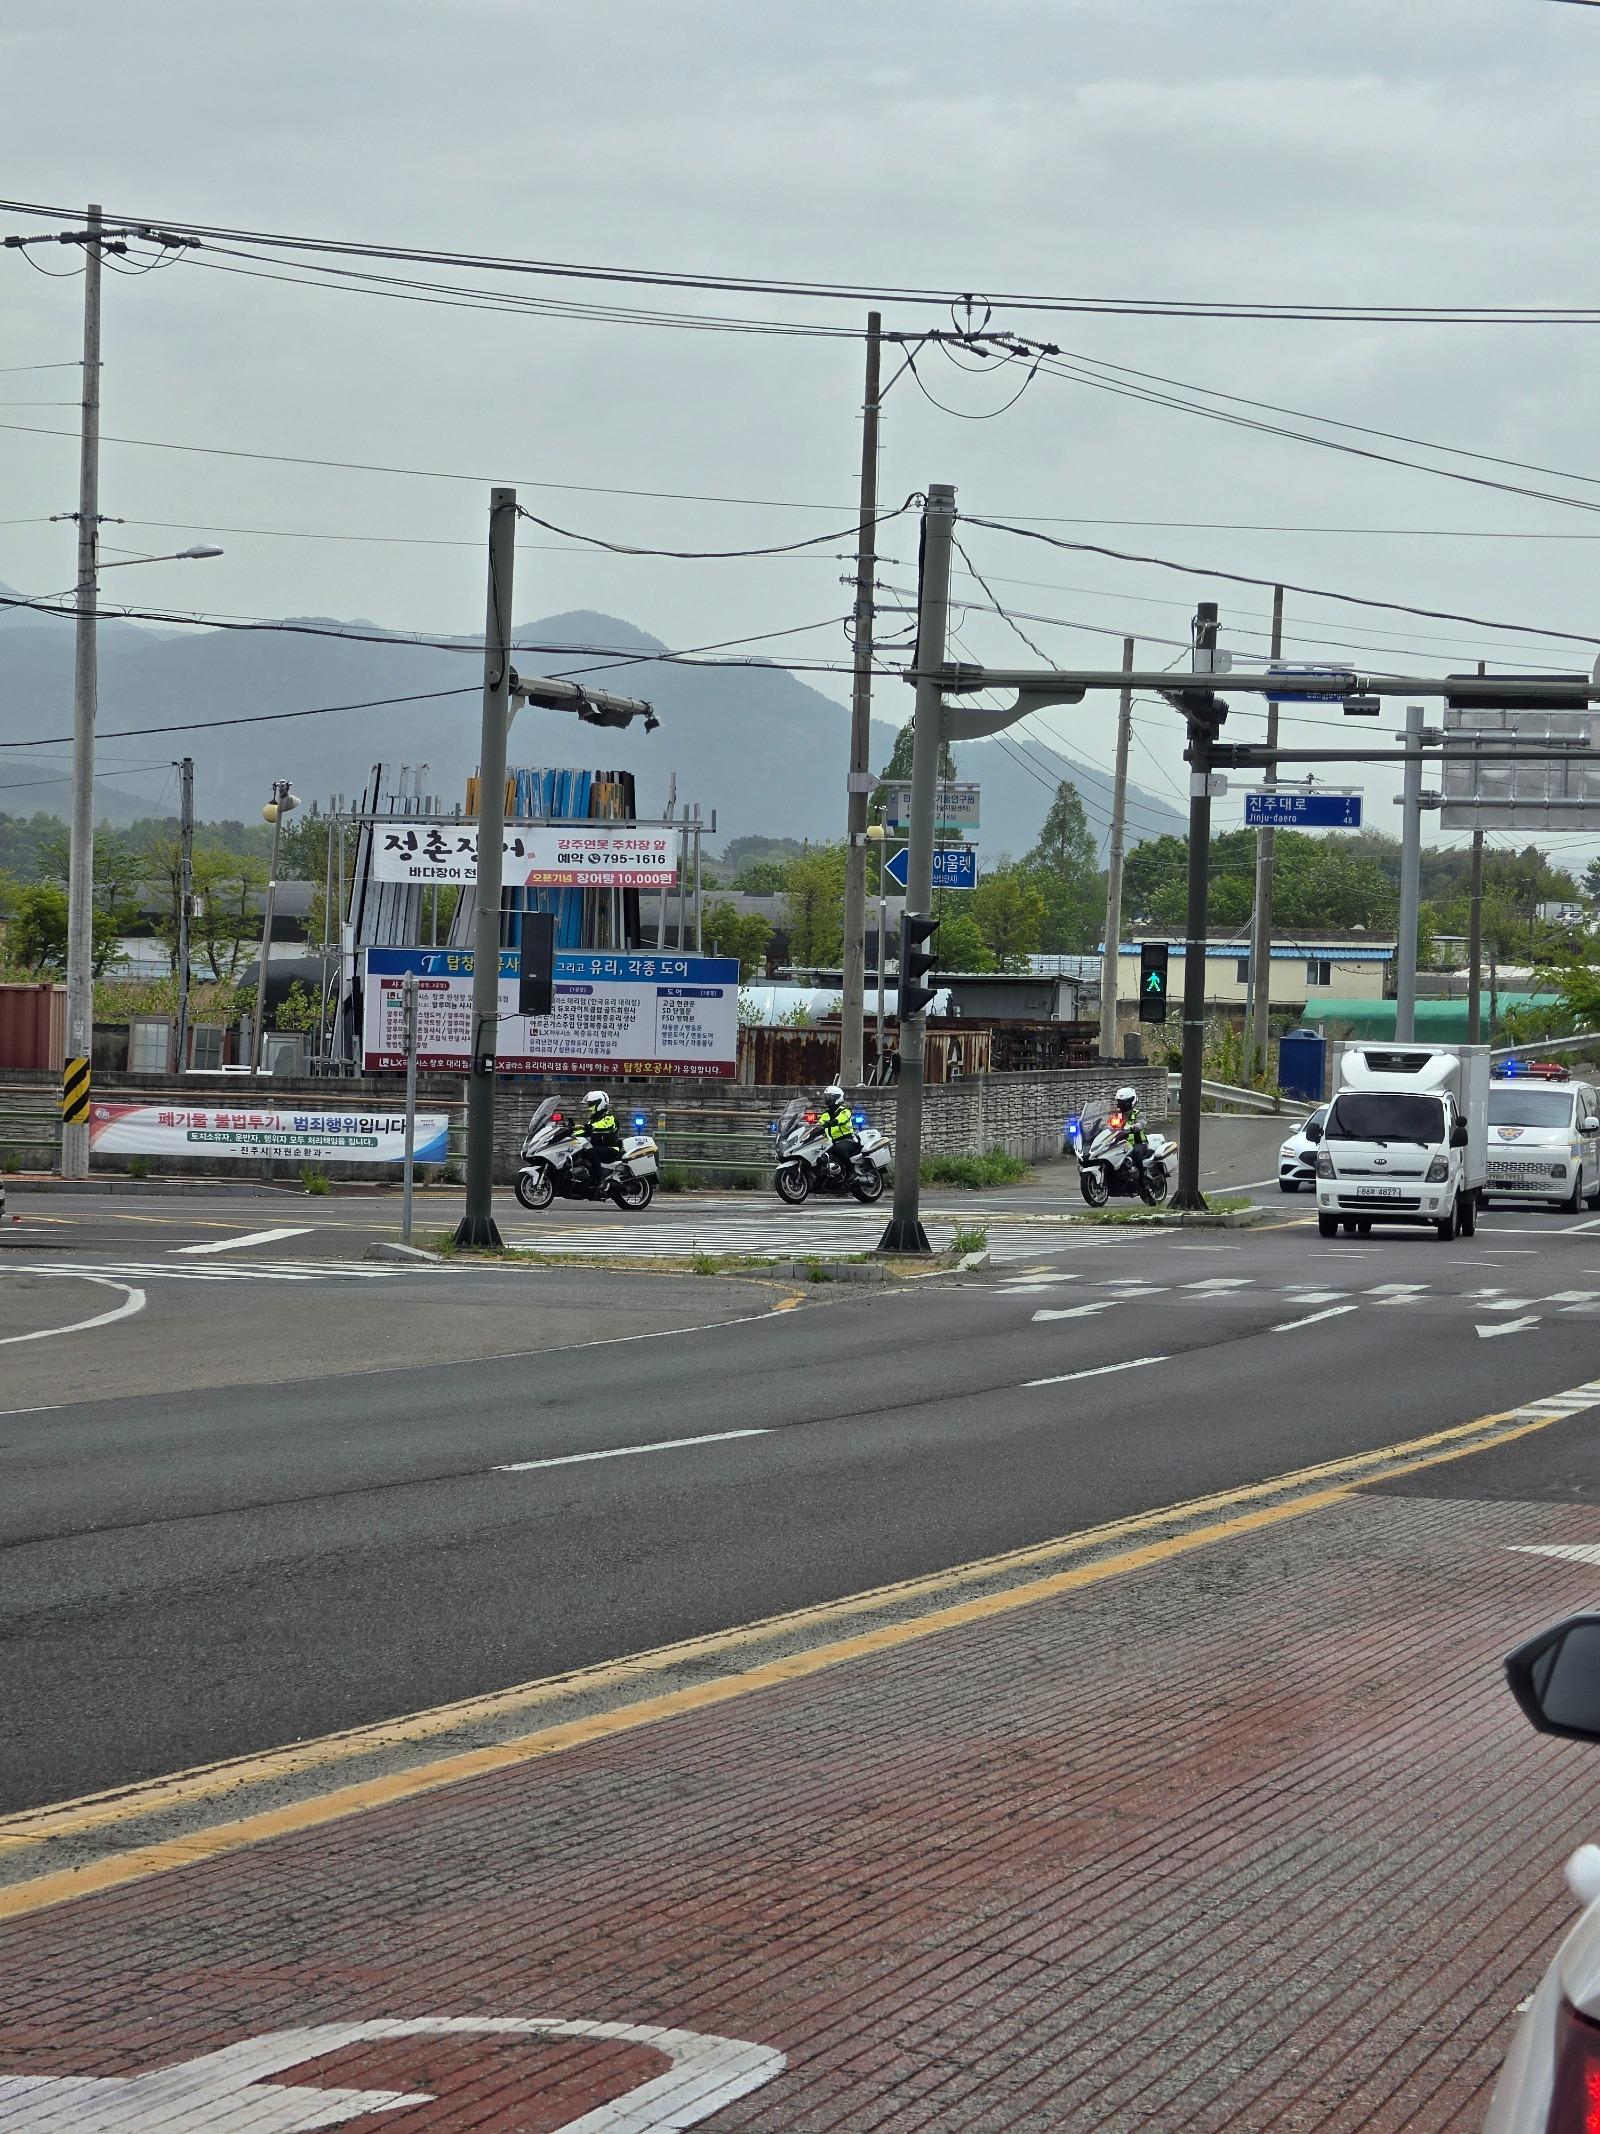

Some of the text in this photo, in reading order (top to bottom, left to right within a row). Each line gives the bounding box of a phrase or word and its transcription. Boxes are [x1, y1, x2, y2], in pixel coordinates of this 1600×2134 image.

[1249, 797, 1307, 812] 진주대로
[1249, 813, 1353, 824] Jinju-daero 48
[558, 839, 666, 851] 강주연못 주차장 앞
[558, 853, 666, 864] 예약 795-1616
[409, 867, 461, 878] 바다장어
[533, 873, 672, 884] 오픈기념 장어탕 10,000원
[557, 962, 585, 973] 그리고
[589, 959, 623, 975] 유리,
[628, 960, 656, 976] 각종
[660, 961, 688, 976] 도어
[430, 1059, 445, 1067] 창호
[594, 1062, 610, 1072] 하는
[158, 1111, 208, 1128] 폐기물
[214, 1114, 286, 1132] 불법투기,
[293, 1116, 407, 1135] 범죄행위입니다
[190, 1132, 232, 1142] 토지소유자,
[234, 1133, 261, 1143] 운반자,
[264, 1134, 287, 1145] 행위자
[289, 1136, 305, 1145] 모두
[307, 1136, 345, 1146] 처리책임을
[240, 1146, 269, 1156] 진주시
[273, 1147, 322, 1158] 자원순환과
